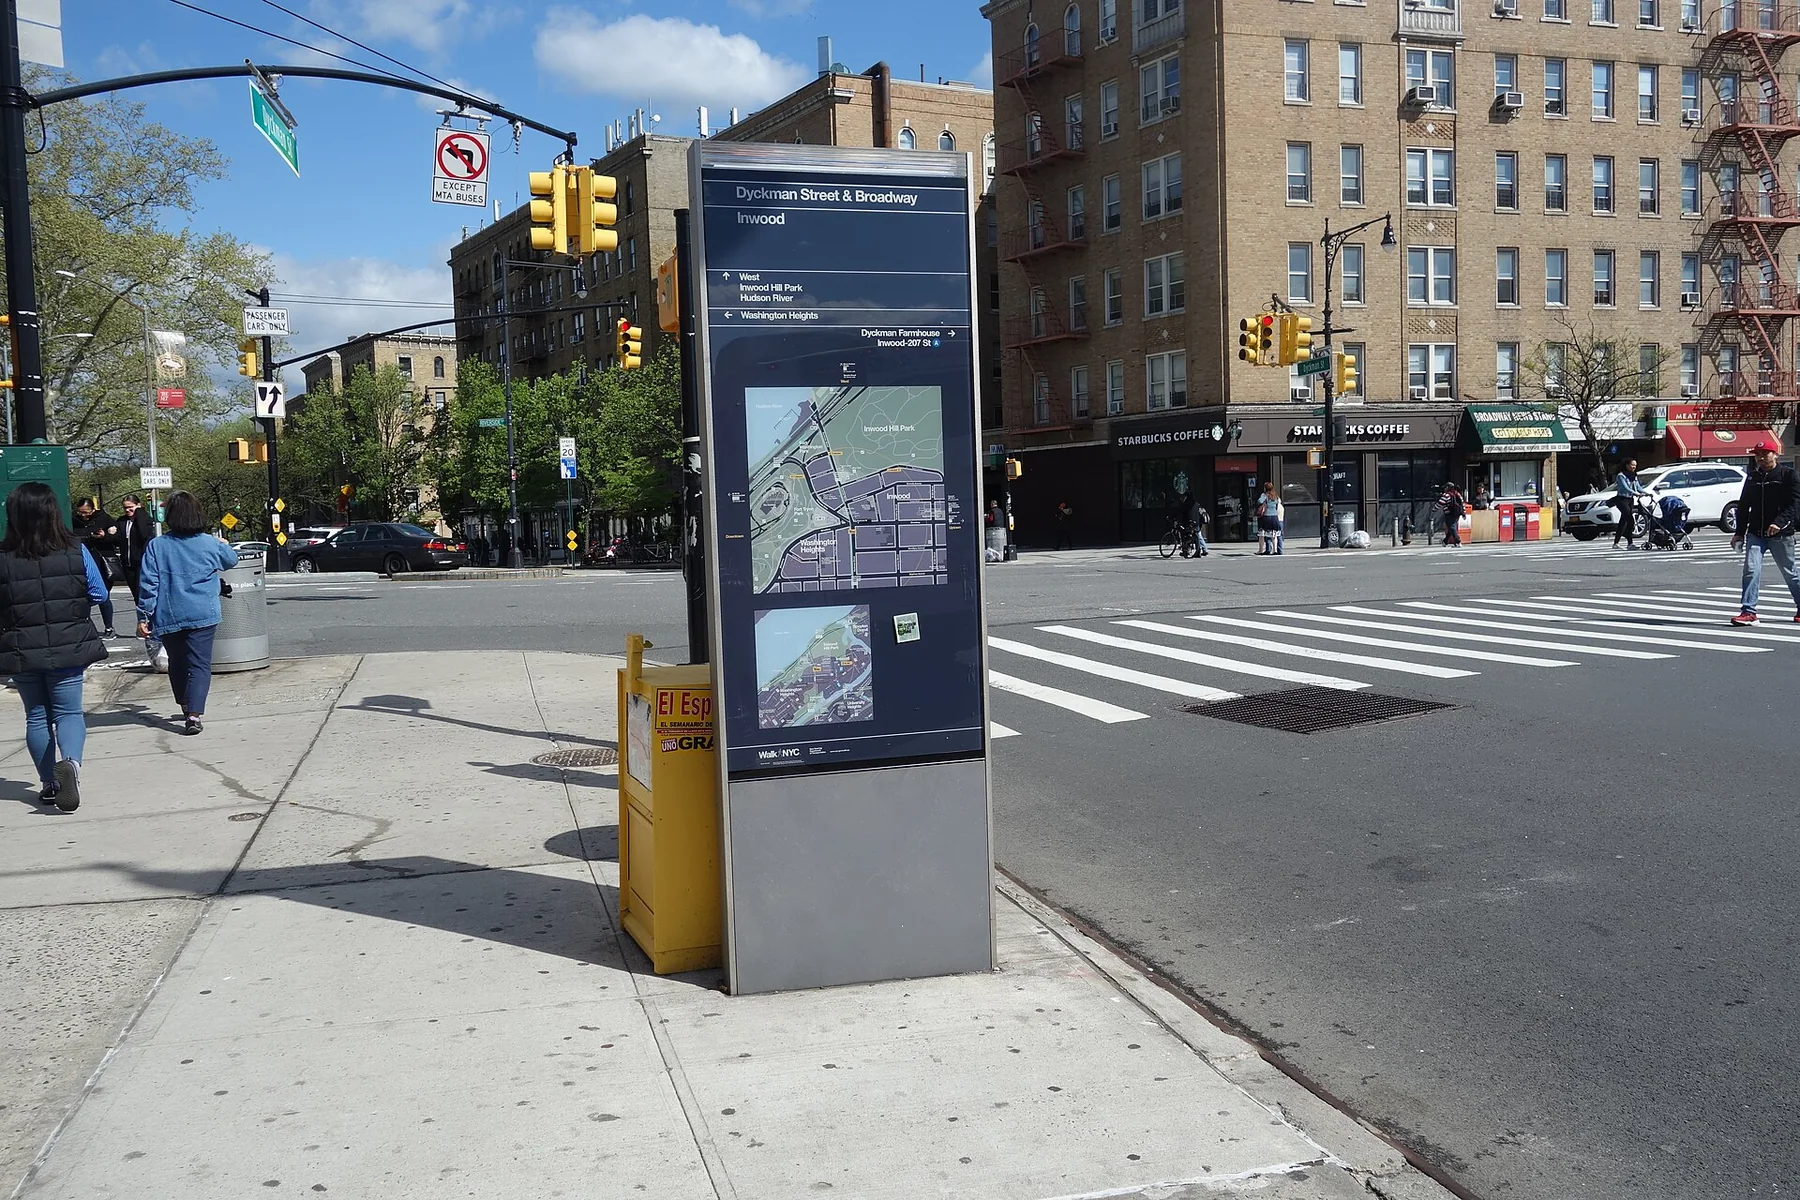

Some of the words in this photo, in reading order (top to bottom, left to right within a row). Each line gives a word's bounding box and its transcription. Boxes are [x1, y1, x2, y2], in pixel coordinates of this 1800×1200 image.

[262, 104, 287, 151] Dyckman
[286, 135, 293, 158] St
[443, 181, 477, 192] EXCEPT
[435, 191, 453, 200] MTA
[456, 193, 484, 203] BUSES
[736, 186, 798, 201] Dyckman
[800, 188, 840, 201] Street
[842, 190, 852, 202] &
[855, 190, 918, 206] Broadway
[737, 211, 785, 225] Inwood
[739, 272, 760, 281] West
[739, 283, 769, 292] Inwood
[770, 283, 783, 292] Hill
[784, 283, 803, 292] Park
[740, 293, 771, 302] Hudson
[772, 293, 794, 302] River
[246, 311, 286, 320] PASSENGER
[740, 310, 787, 321] Washington
[788, 311, 819, 321] Heights
[247, 321, 265, 331] CARS
[269, 322, 286, 331] ONLY
[861, 328, 897, 338] Dyckman
[898, 328, 941, 337] Farmhouse
[877, 338, 921, 347] Inwood-207
[922, 339, 932, 347] St
[1303, 361, 1320, 373] Dyckman
[1474, 411, 1513, 421] BROADWAY
[1293, 425, 1365, 436] STARKS
[1366, 424, 1410, 434] COFFEE
[1117, 432, 1172, 447] STARBUCKS
[1173, 428, 1210, 441] COFFEE
[562, 448, 574, 457] 20
[886, 492, 911, 500] Inwood
[800, 539, 837, 547] Washington
[800, 546, 825, 554] Heights
[658, 691, 674, 715] El
[681, 691, 712, 721] Esp
[661, 740, 677, 751] UNO
[758, 750, 778, 759] Walk
[782, 748, 800, 757] NYC
